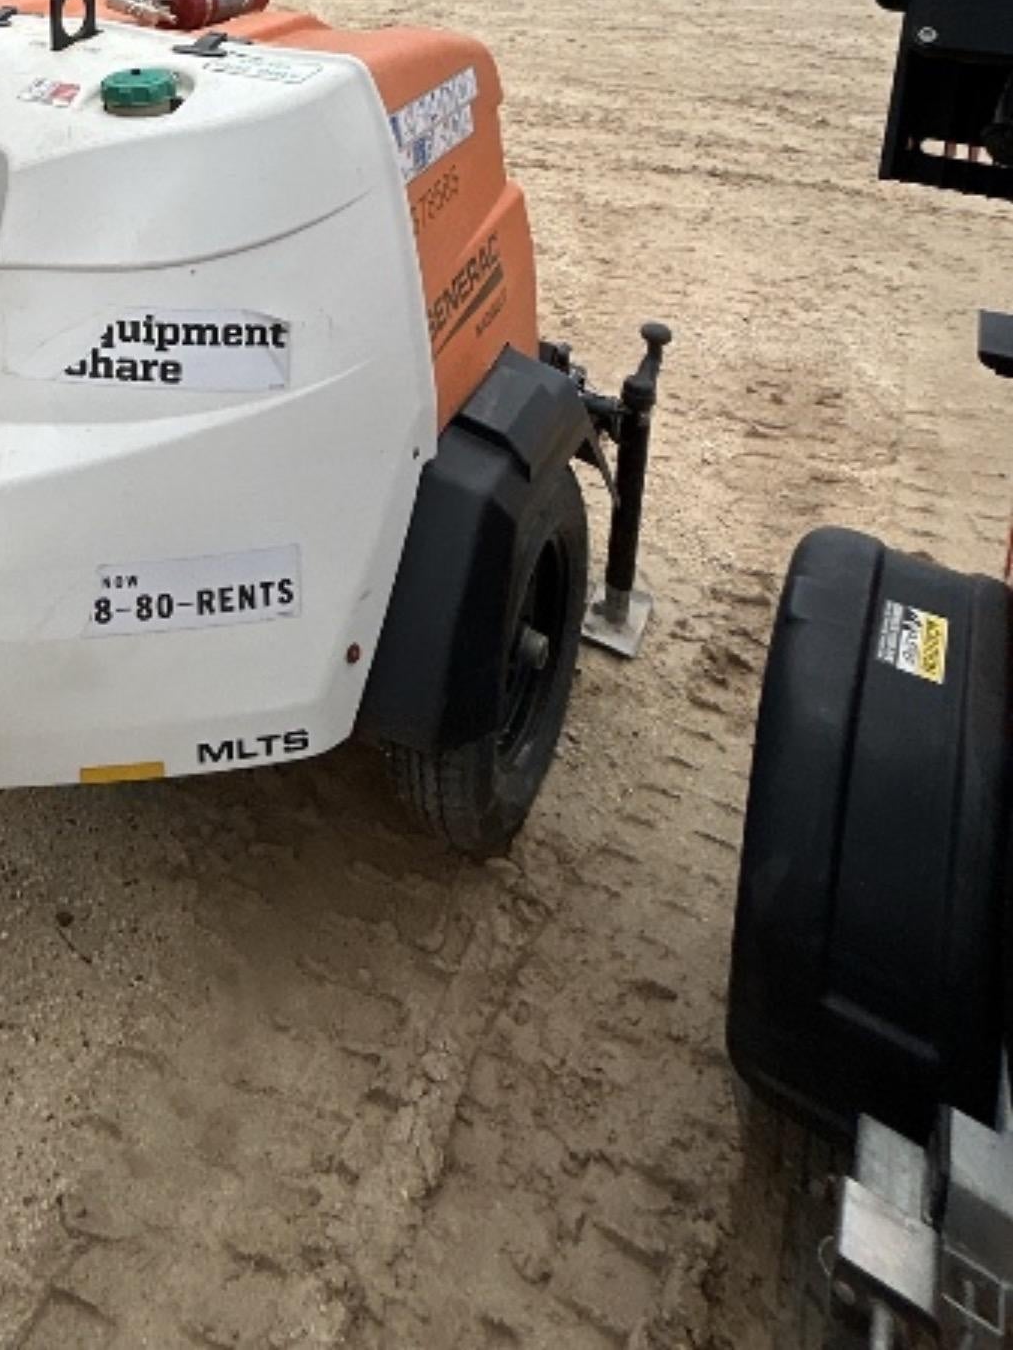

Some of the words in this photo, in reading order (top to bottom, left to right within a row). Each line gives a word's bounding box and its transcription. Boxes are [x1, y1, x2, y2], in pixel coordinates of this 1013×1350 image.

[94, 578, 295, 624] 8-80-RENTS
[101, 575, 139, 589] NOW
[196, 728, 309, 766] MLTS
